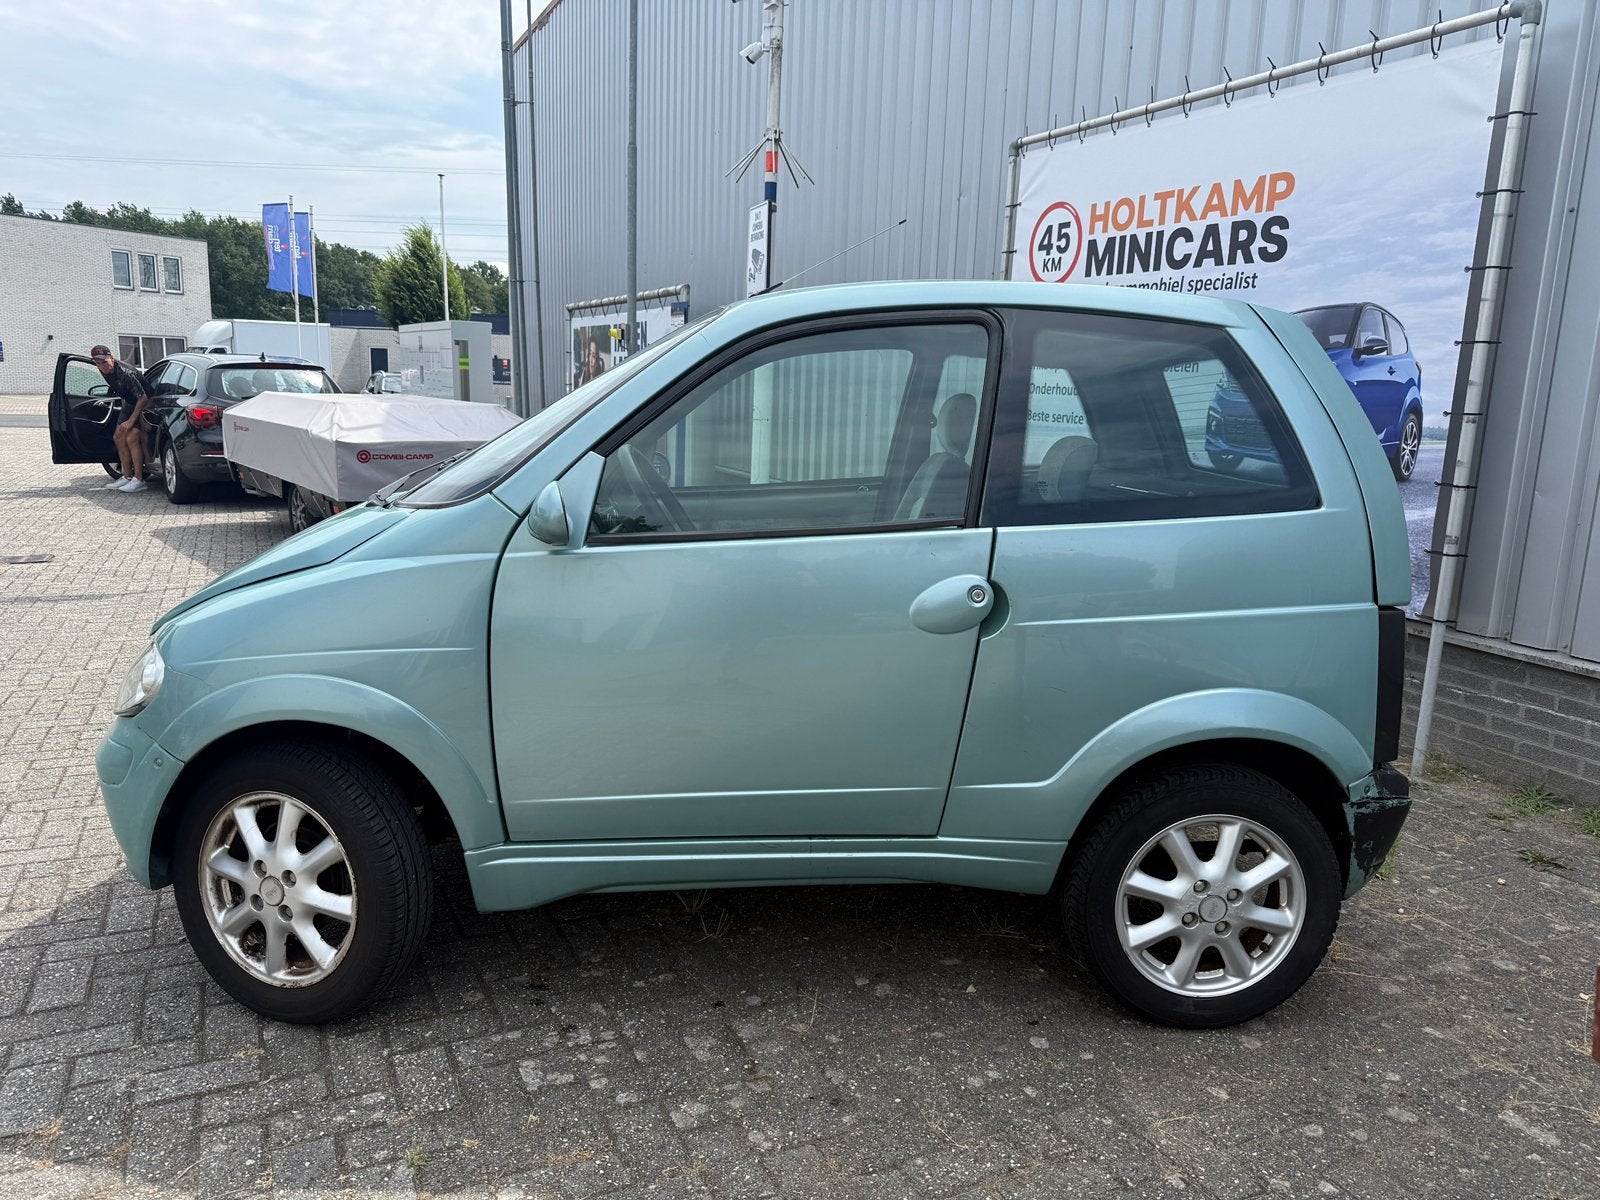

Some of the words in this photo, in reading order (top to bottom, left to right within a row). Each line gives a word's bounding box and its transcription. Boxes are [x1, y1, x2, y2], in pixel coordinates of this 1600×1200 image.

[1088, 171, 1296, 235] HOLTKAMP
[1038, 221, 1071, 256] 45
[1084, 215, 1290, 278] MINICARS
[1042, 256, 1063, 273] KM
[1187, 272, 1258, 294] specialist
[1026, 410, 1050, 422] Beste
[1052, 411, 1084, 425] service
